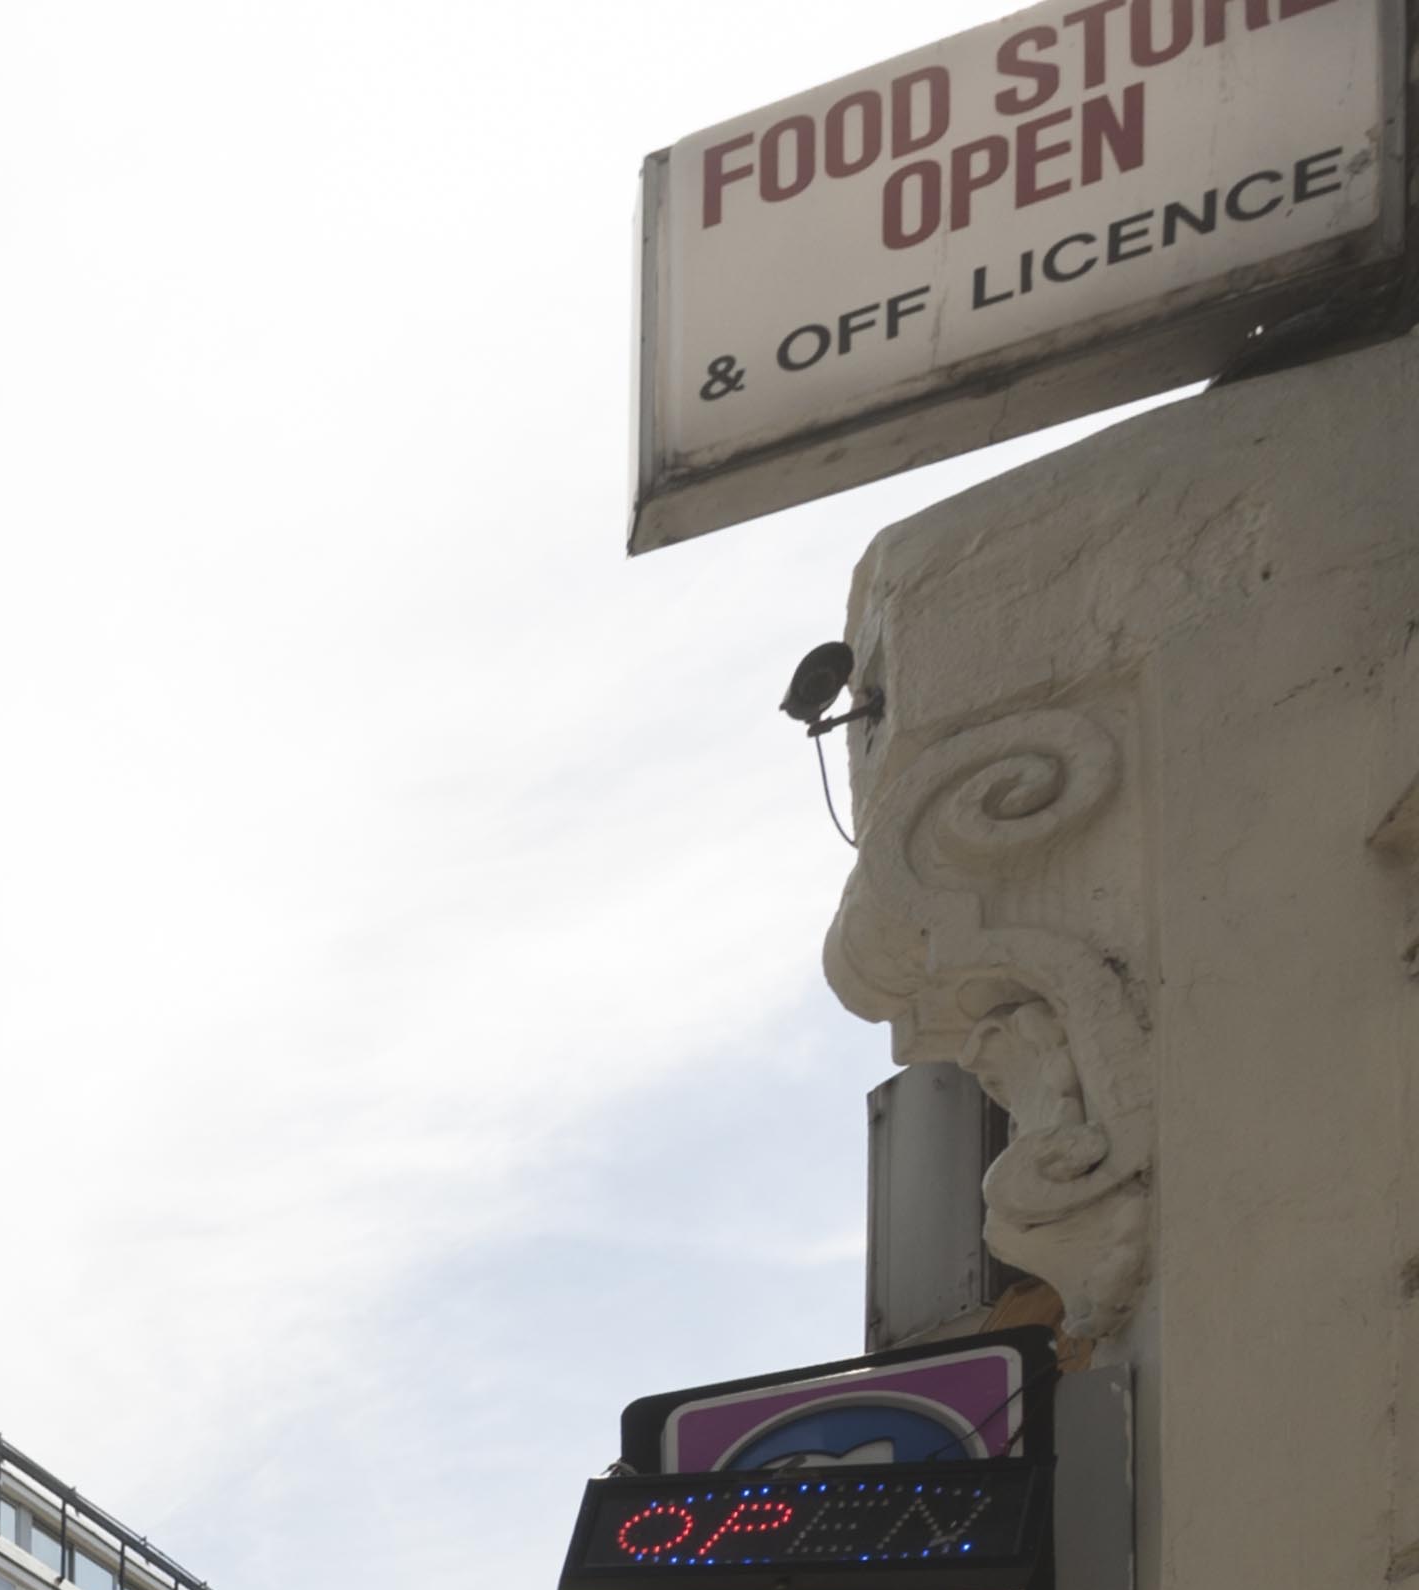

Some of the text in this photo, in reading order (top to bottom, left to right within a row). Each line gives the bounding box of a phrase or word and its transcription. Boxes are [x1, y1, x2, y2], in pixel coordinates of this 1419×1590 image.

[702, 0, 1340, 230] FOOD STO
[882, 81, 1146, 251] OPEN
[699, 146, 1344, 402] & OFF LICENCE
